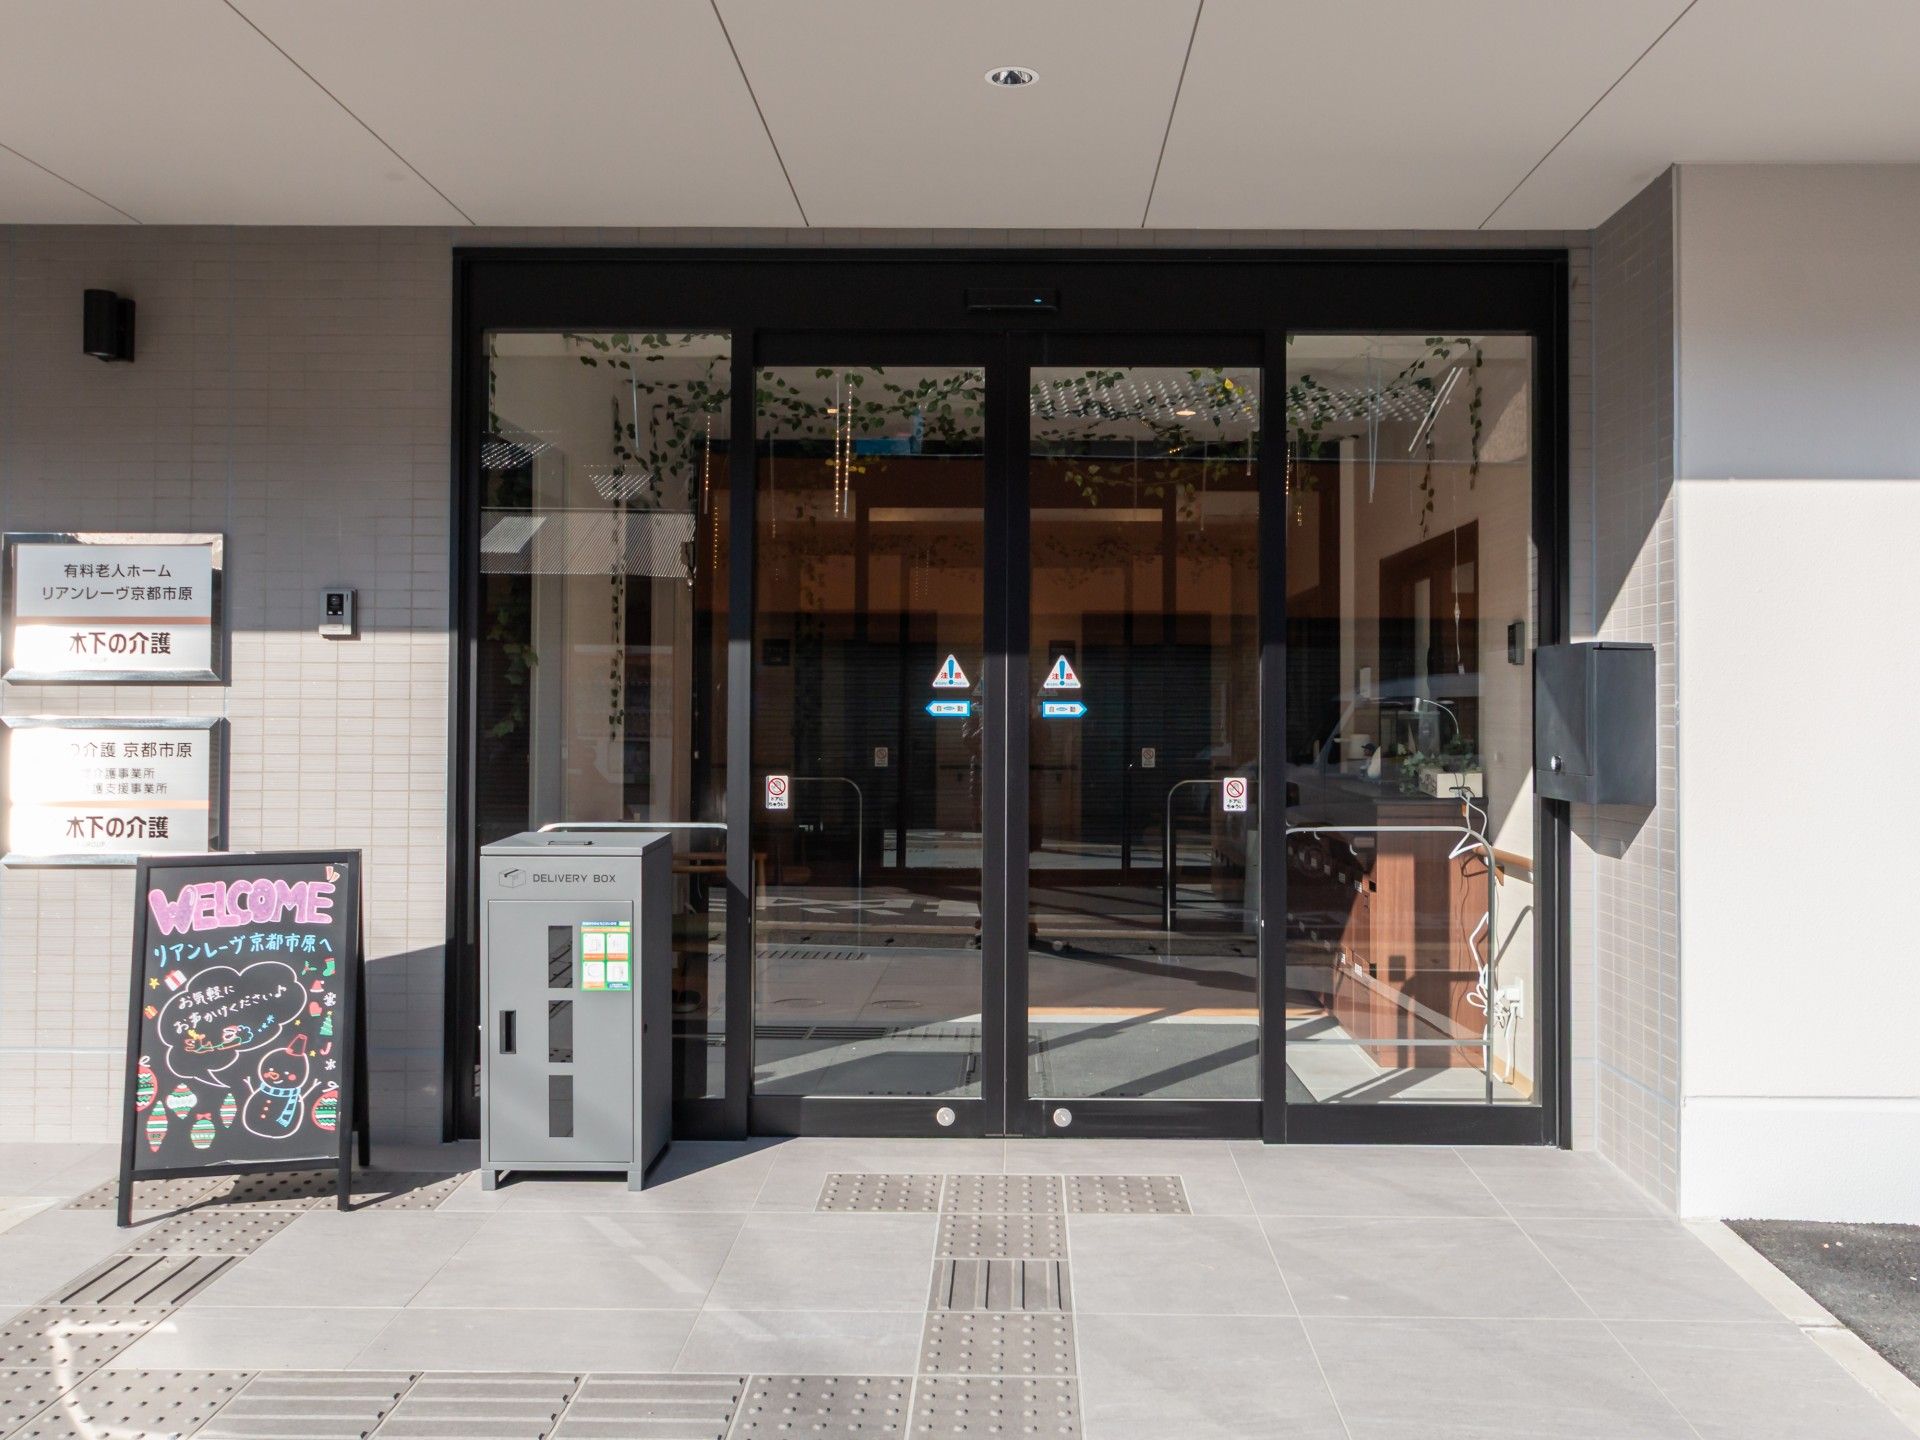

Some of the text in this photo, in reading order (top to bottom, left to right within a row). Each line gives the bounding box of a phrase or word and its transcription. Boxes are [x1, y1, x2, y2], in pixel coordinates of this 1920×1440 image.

[64, 564, 171, 578] 有料老人ホーム
[42, 586, 192, 601] リアンレーヴ京都市原
[70, 632, 171, 654] 木下の介護
[123, 742, 192, 758] 京都市原
[66, 816, 168, 838] 木下の介護
[533, 873, 616, 883] DELIVERY BOX
[149, 879, 335, 935] WELCOME
[154, 933, 333, 967] リアンレーヴ京都市原へ
[179, 986, 235, 1010] お気軽に
